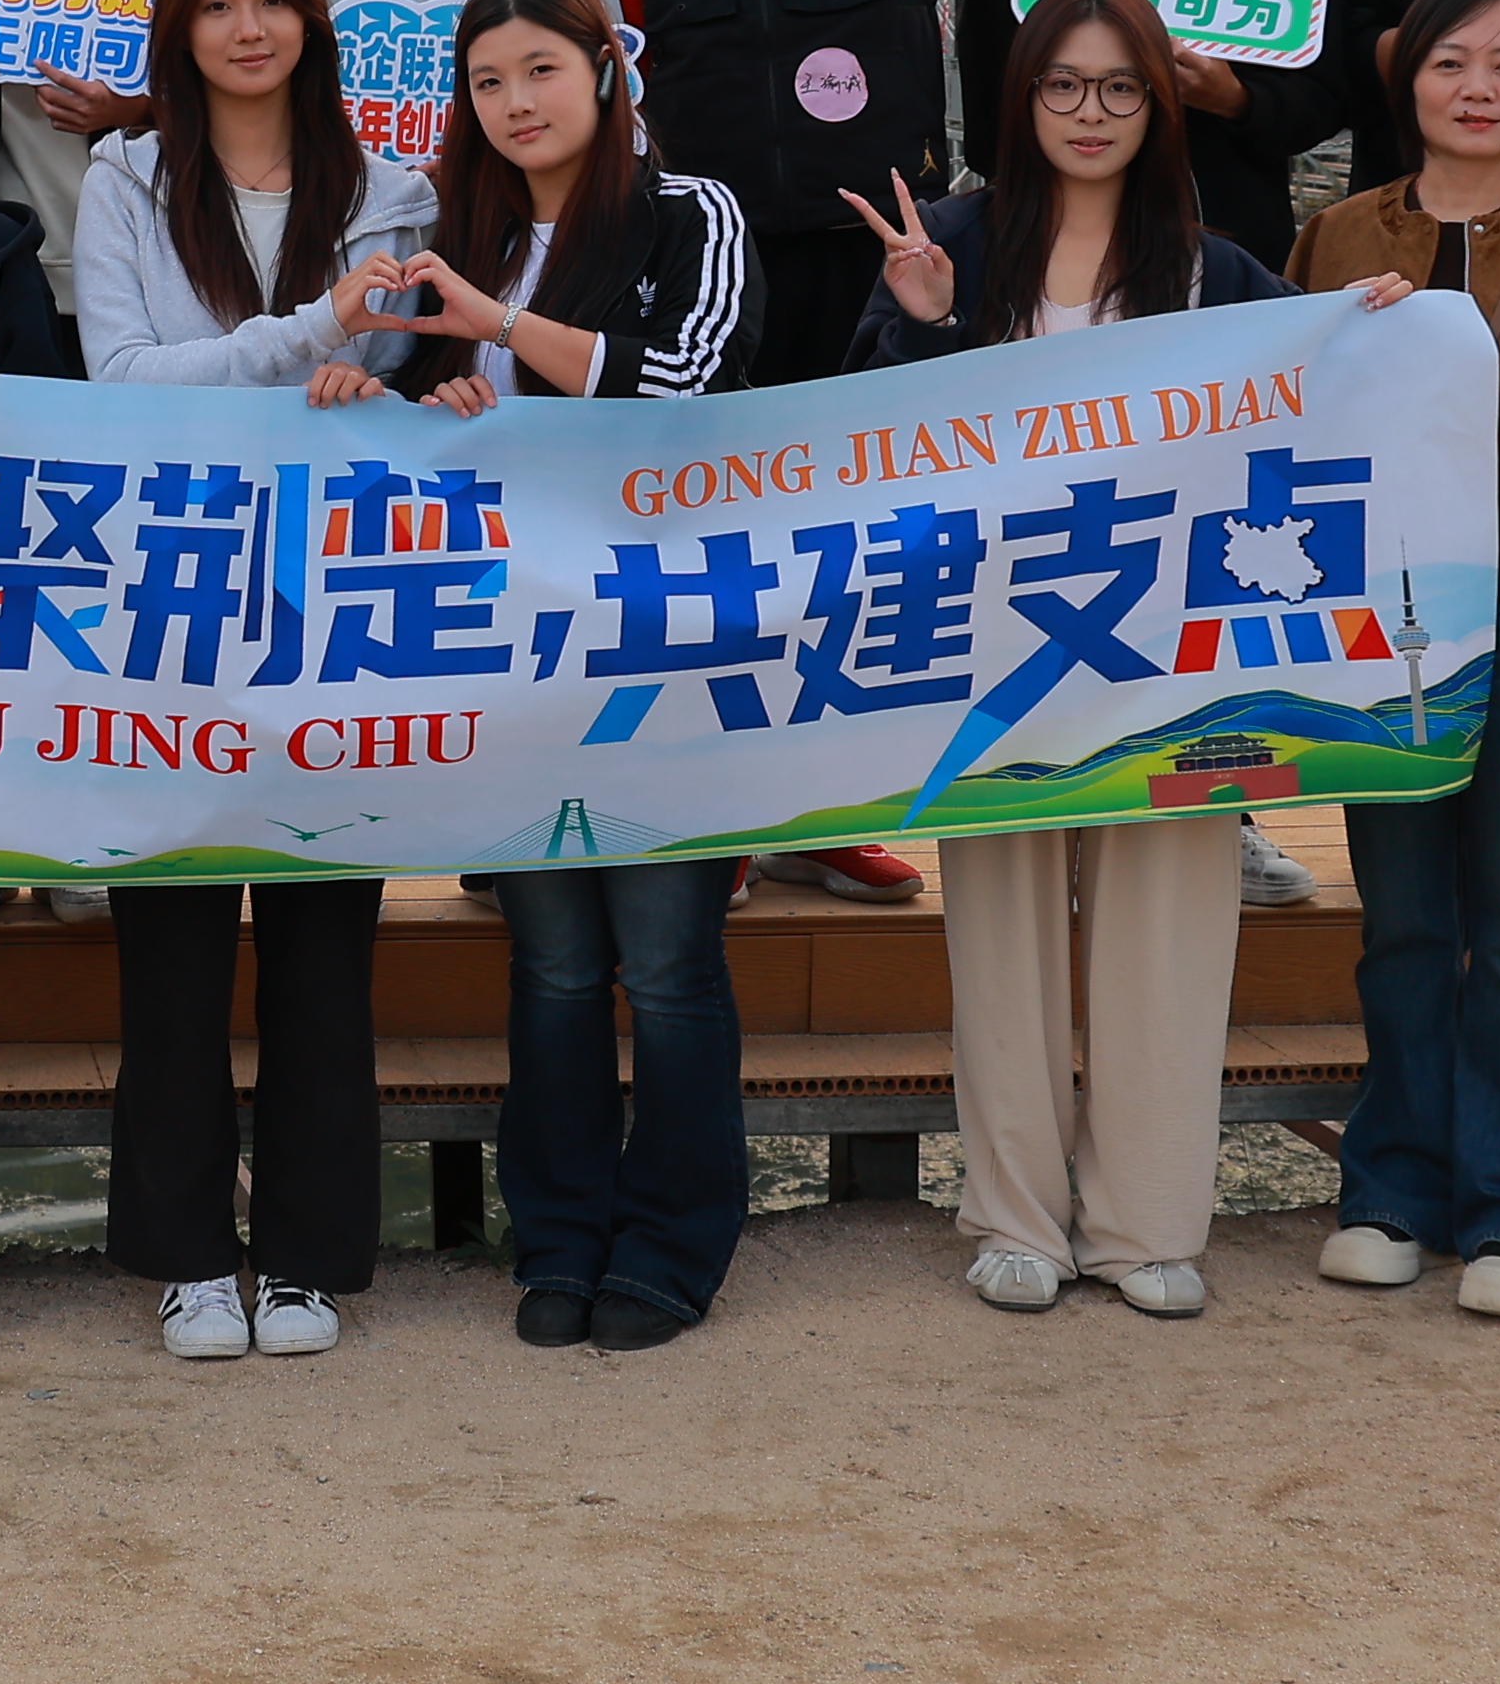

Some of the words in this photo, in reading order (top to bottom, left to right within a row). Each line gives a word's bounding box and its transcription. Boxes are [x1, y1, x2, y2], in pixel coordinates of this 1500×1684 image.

[340, 99, 456, 154] 年创
[621, 442, 814, 517] GONG
[837, 414, 997, 486] JIAN
[1015, 394, 1133, 462] ZHI
[1151, 364, 1305, 443] DIAN
[37, 704, 255, 773] JING
[287, 710, 483, 770] CHU
